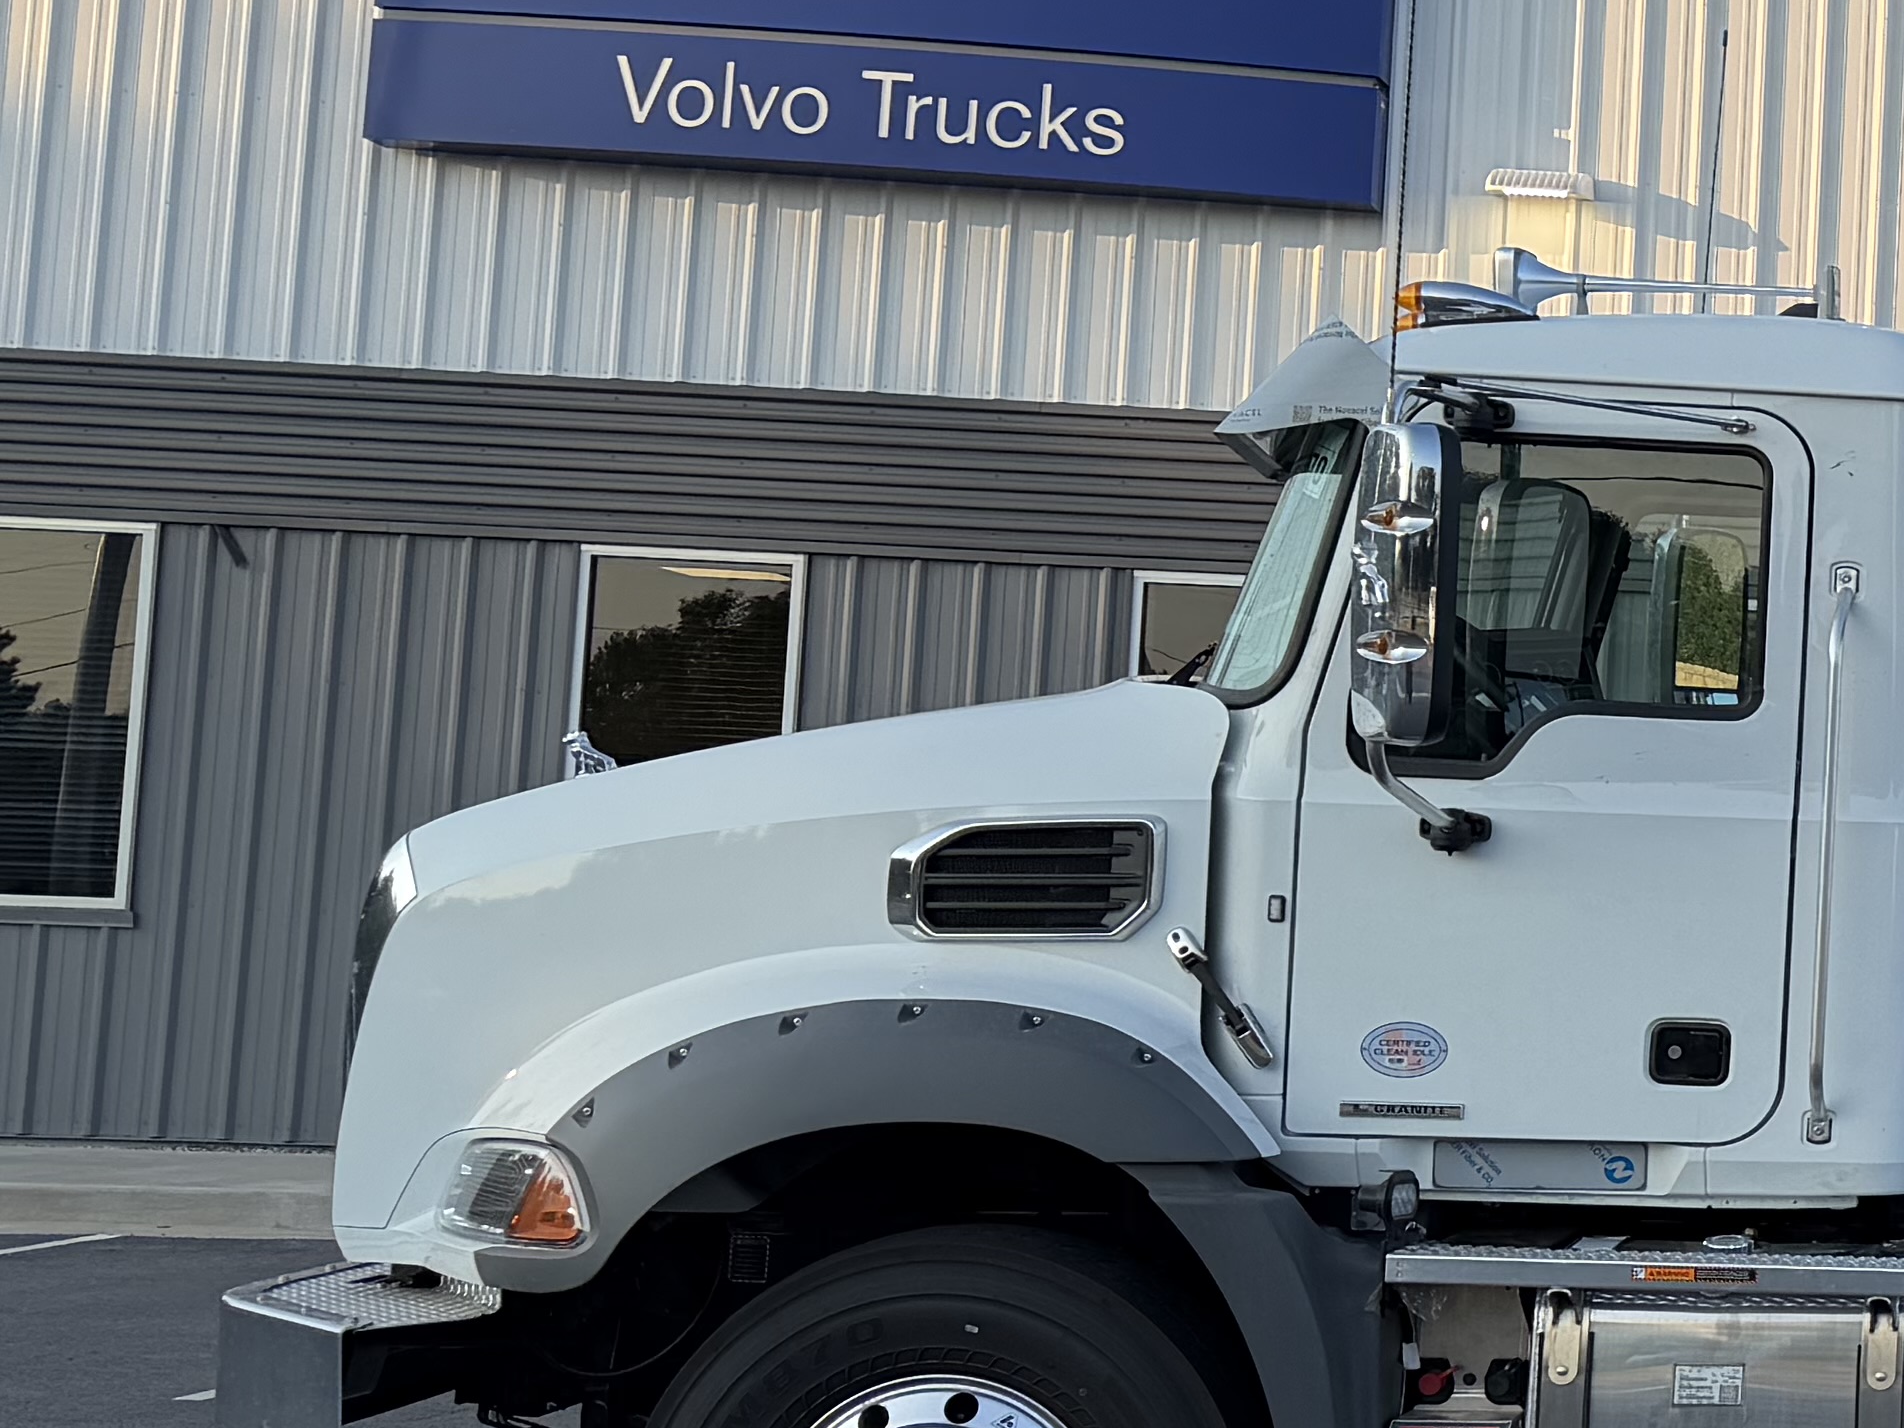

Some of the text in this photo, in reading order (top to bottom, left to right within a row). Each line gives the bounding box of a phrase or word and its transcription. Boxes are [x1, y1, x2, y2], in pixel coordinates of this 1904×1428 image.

[614, 52, 1126, 157] Volvo Trucks
[1379, 1039, 1431, 1048] CERTIFIED
[1374, 1048, 1436, 1057] CLEAN IDLE
[1374, 1104, 1449, 1117] GRANITE
